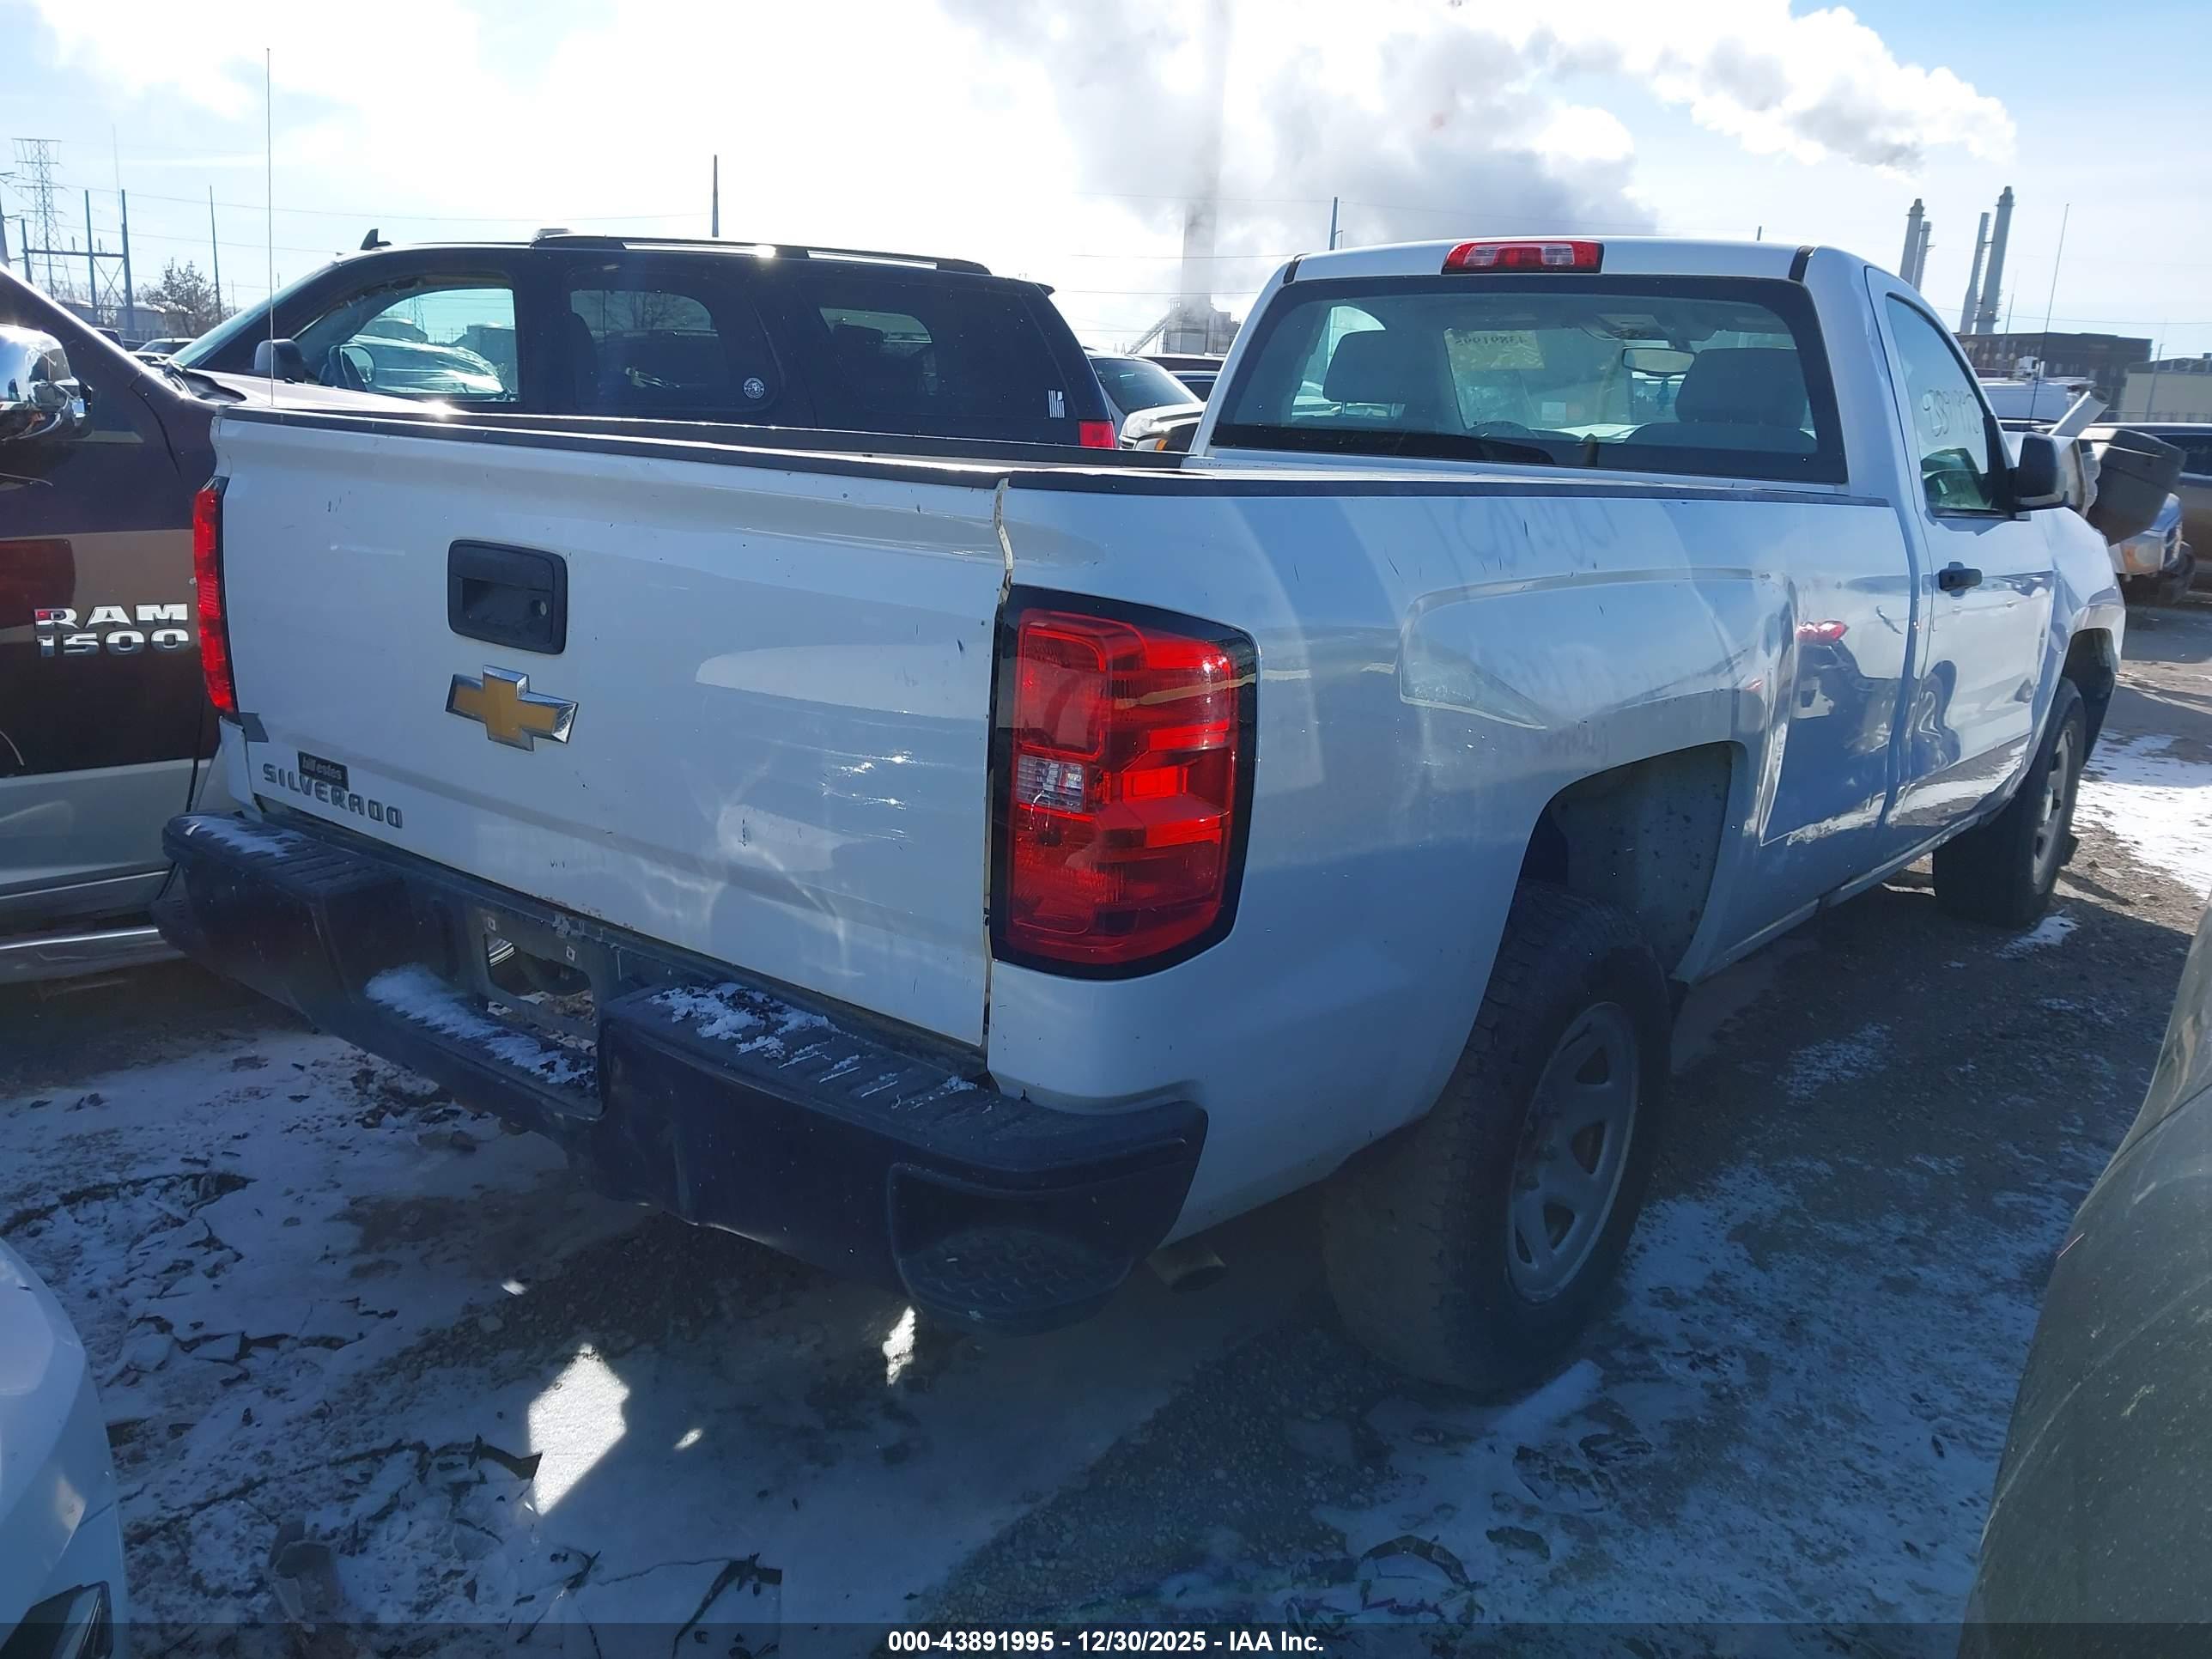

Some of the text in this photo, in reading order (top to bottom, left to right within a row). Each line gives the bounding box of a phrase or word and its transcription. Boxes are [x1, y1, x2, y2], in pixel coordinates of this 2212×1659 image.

[33, 603, 189, 629] RAM
[37, 629, 190, 657] 1500
[262, 763, 403, 829] SILVERADO
